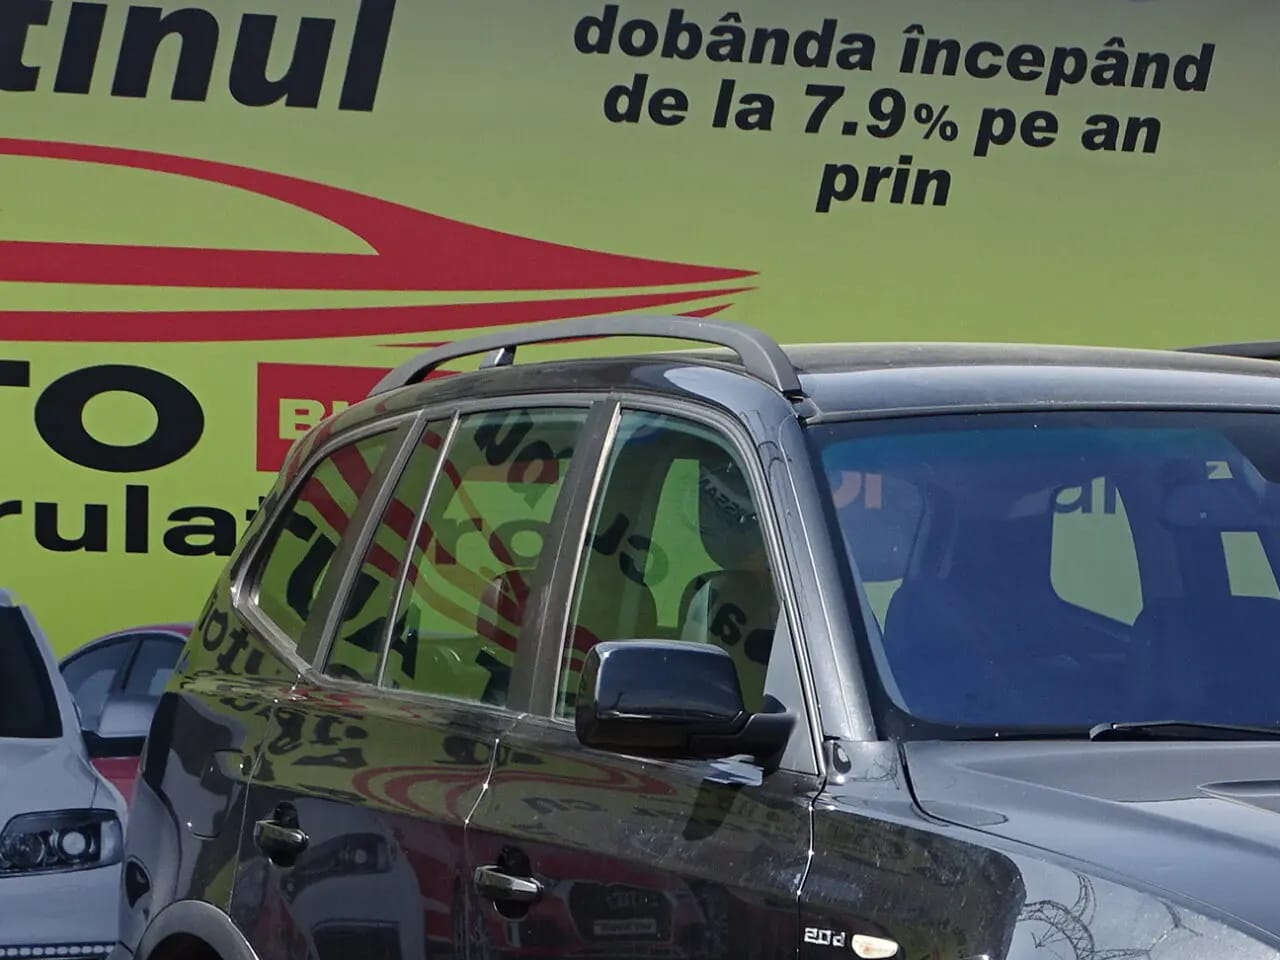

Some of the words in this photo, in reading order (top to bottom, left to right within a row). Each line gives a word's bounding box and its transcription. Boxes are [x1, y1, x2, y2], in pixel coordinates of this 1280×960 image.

[573, 3, 877, 72] dobânda
[899, 23, 1215, 96] începând
[603, 73, 689, 127] de
[712, 79, 775, 131] la
[804, 83, 959, 142] 7.9%
[973, 103, 1059, 158] pe
[1081, 111, 1162, 154] an
[815, 155, 952, 213] prin
